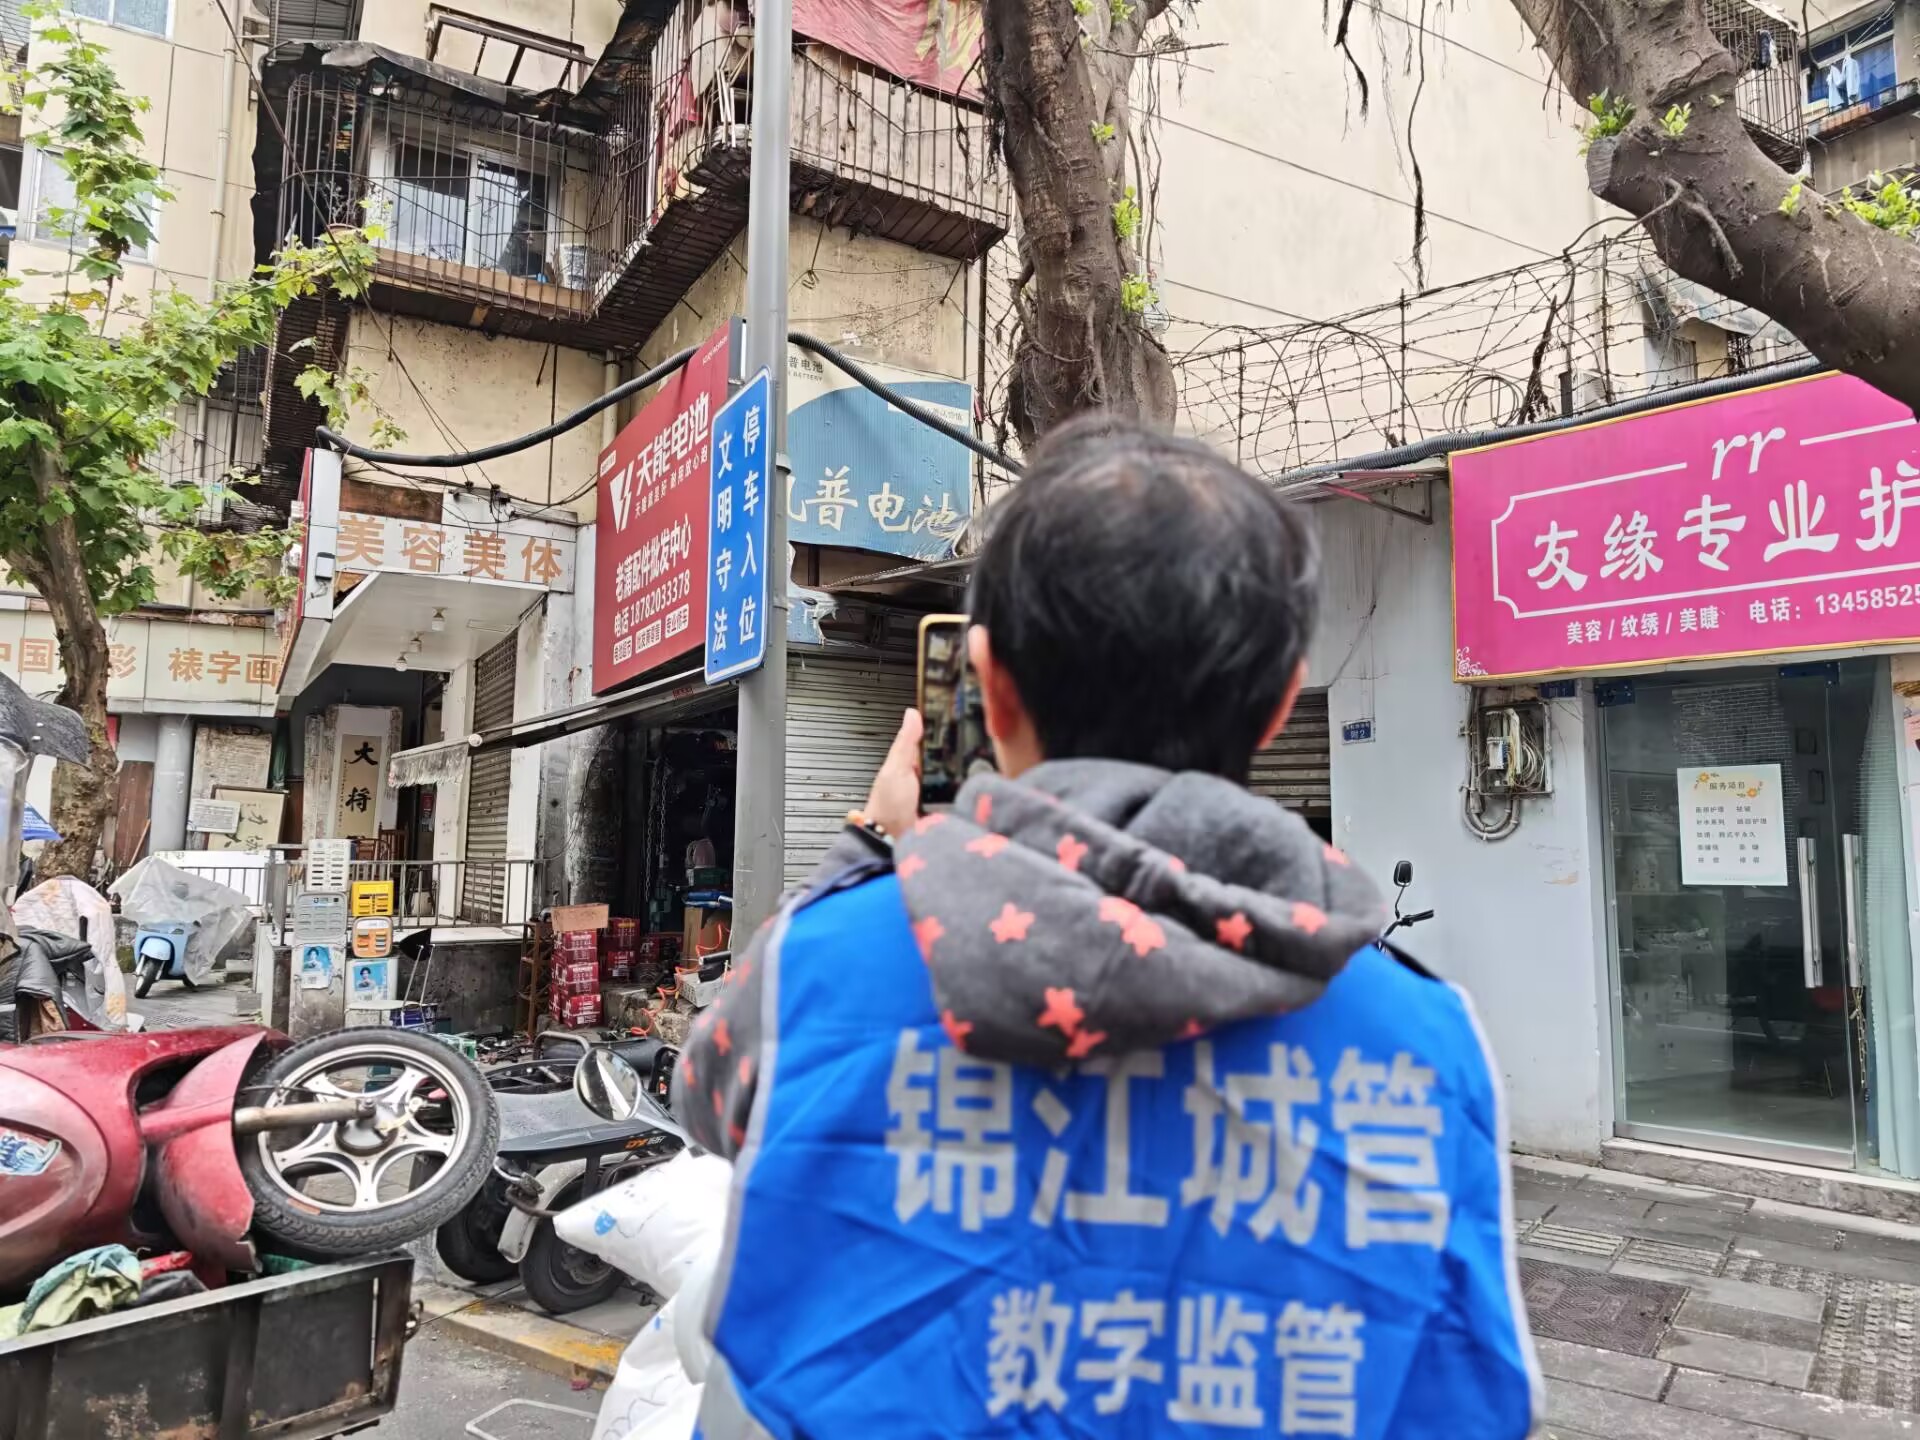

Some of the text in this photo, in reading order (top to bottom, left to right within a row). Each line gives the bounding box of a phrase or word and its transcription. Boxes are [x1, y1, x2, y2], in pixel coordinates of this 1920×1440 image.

[636, 391, 709, 496] 天能电池
[1712, 426, 1785, 480] rr
[336, 514, 563, 583] 美容美体
[712, 430, 732, 652] 文明守法
[738, 405, 760, 645] 停车入位
[1527, 459, 1920, 592] 友缘专业护
[614, 569, 690, 637] 电话 18782033378
[168, 648, 280, 687] 裱字画
[884, 1029, 1451, 1251] 锦江城管
[986, 1283, 1366, 1439] 数字监管
